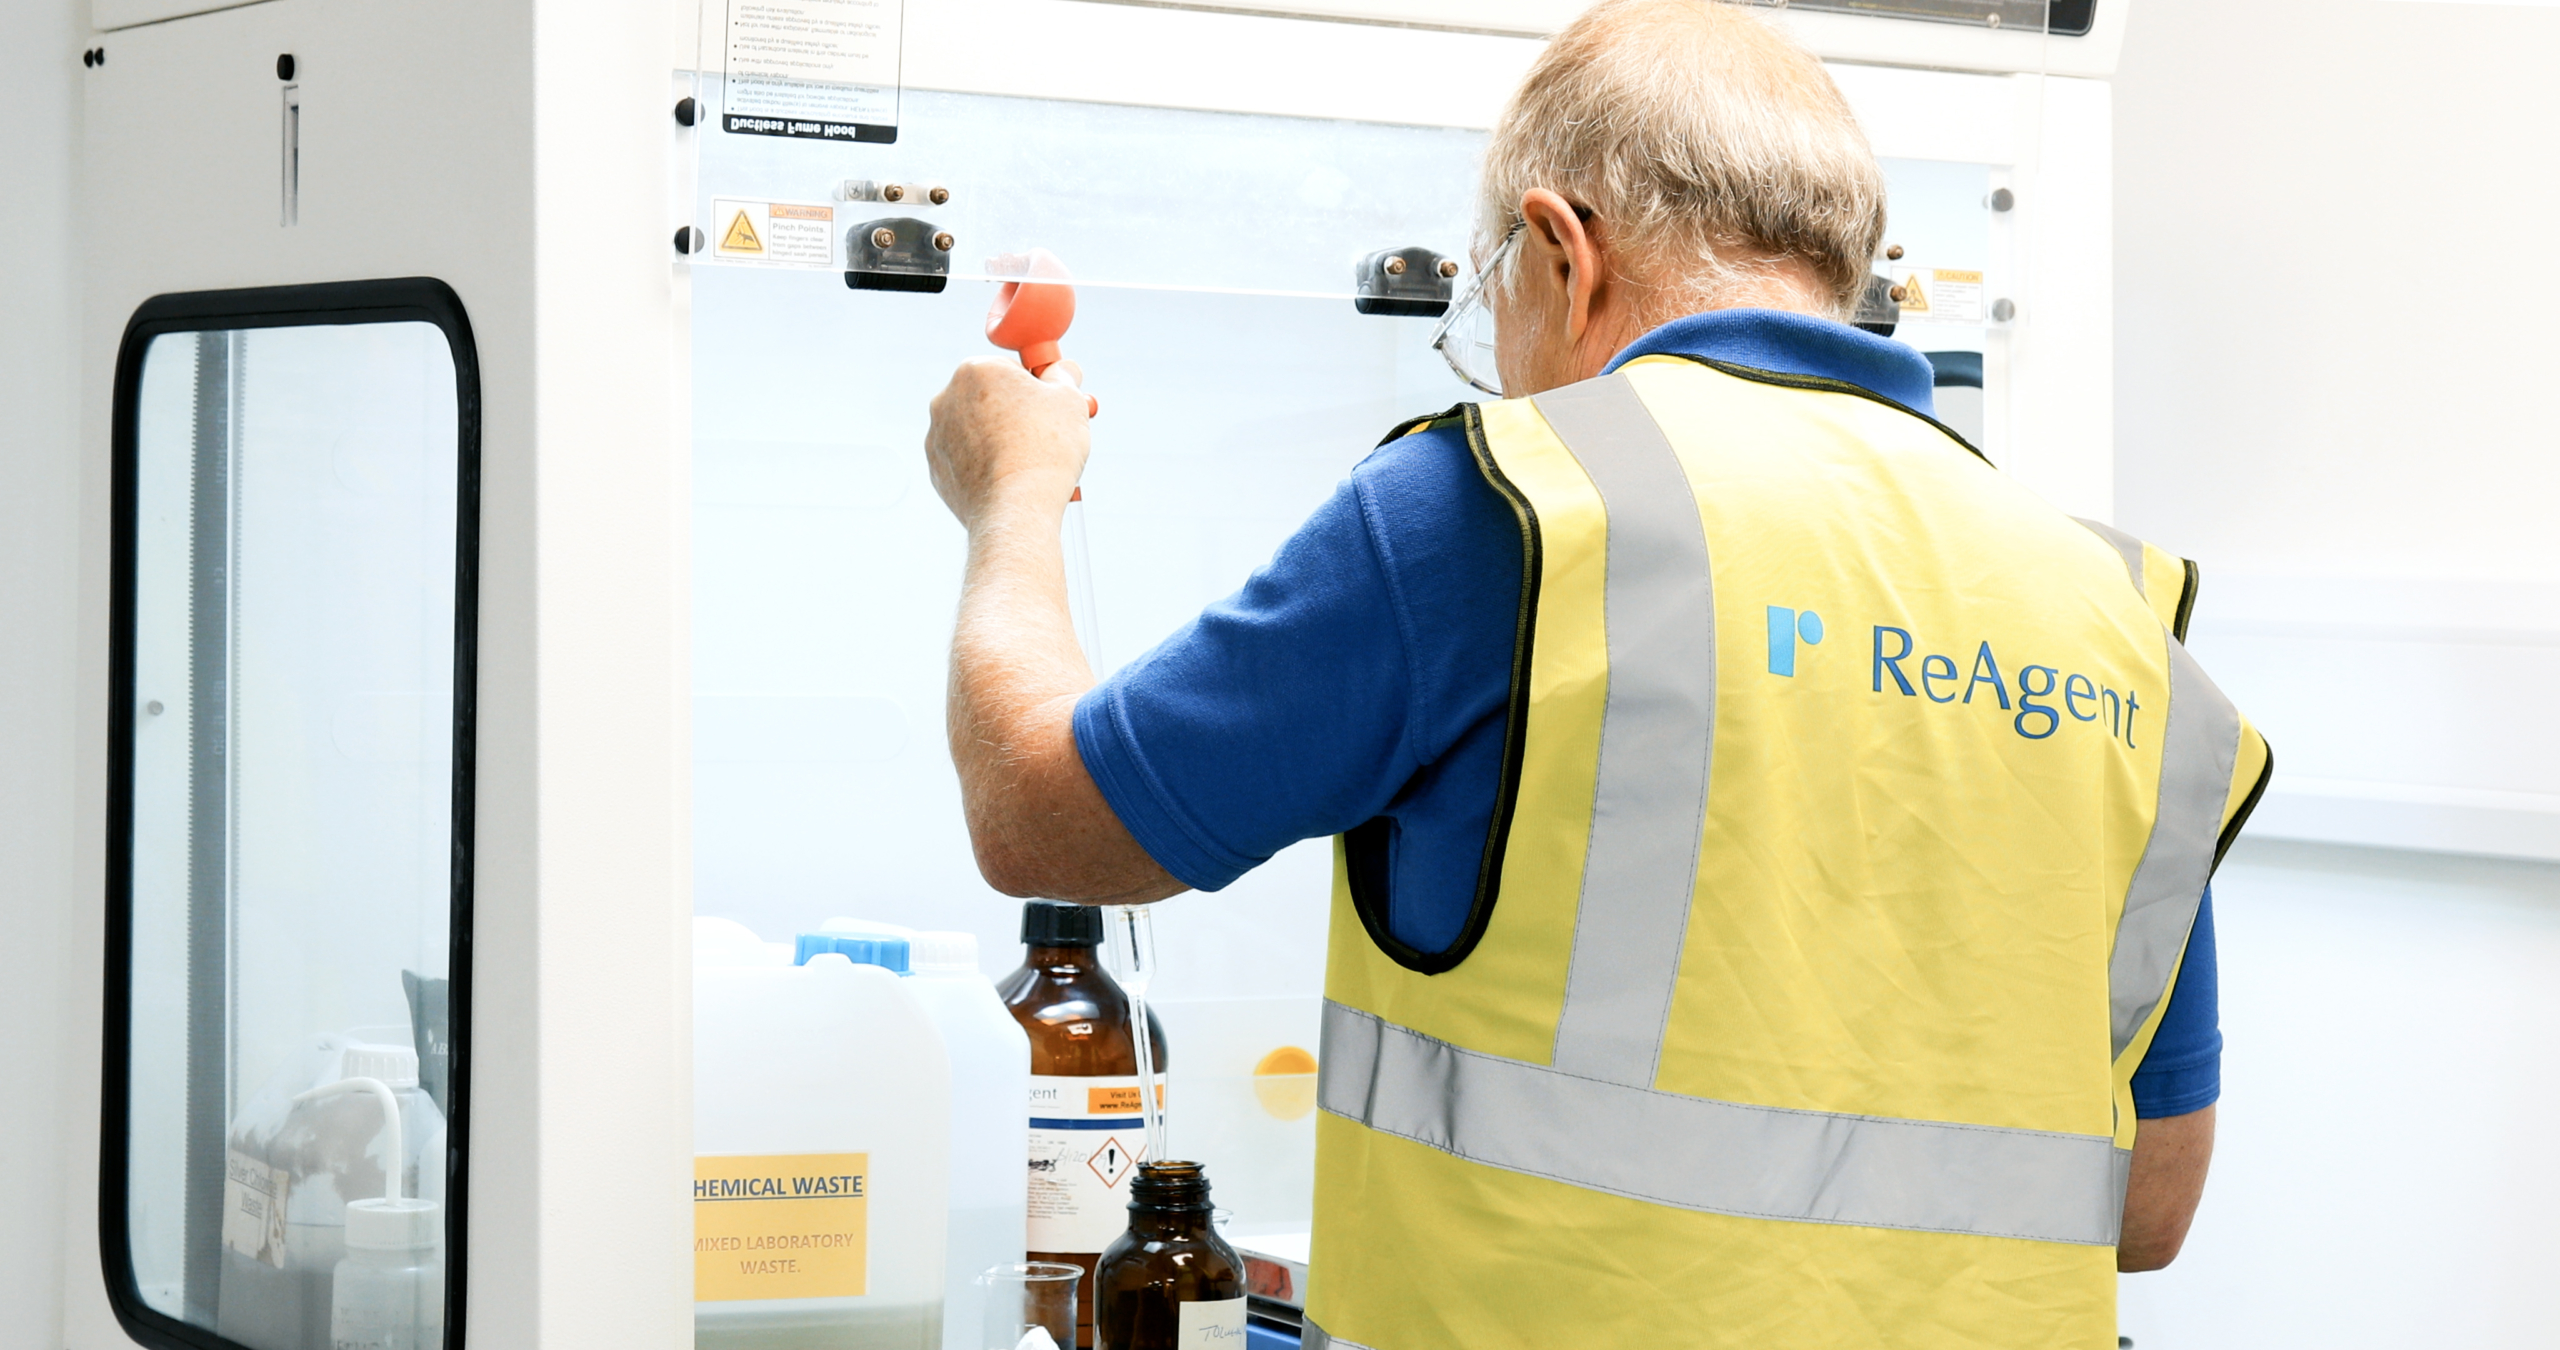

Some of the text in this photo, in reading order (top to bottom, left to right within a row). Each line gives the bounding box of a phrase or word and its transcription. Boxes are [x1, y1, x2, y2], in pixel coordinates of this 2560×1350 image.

[785, 208, 828, 218] WARNING
[773, 222, 826, 233] Pinch Points.
[1946, 272, 1979, 281] CAUTION
[1872, 624, 2141, 750] ReAgent
[1127, 1090, 1136, 1098] Us
[230, 1159, 249, 1181] Silver
[694, 1175, 864, 1197] HEMICAL WASTE
[241, 1190, 262, 1217] Waste
[694, 1233, 854, 1252] MIXED LABORATORY
[740, 1258, 801, 1275] WASTE.
